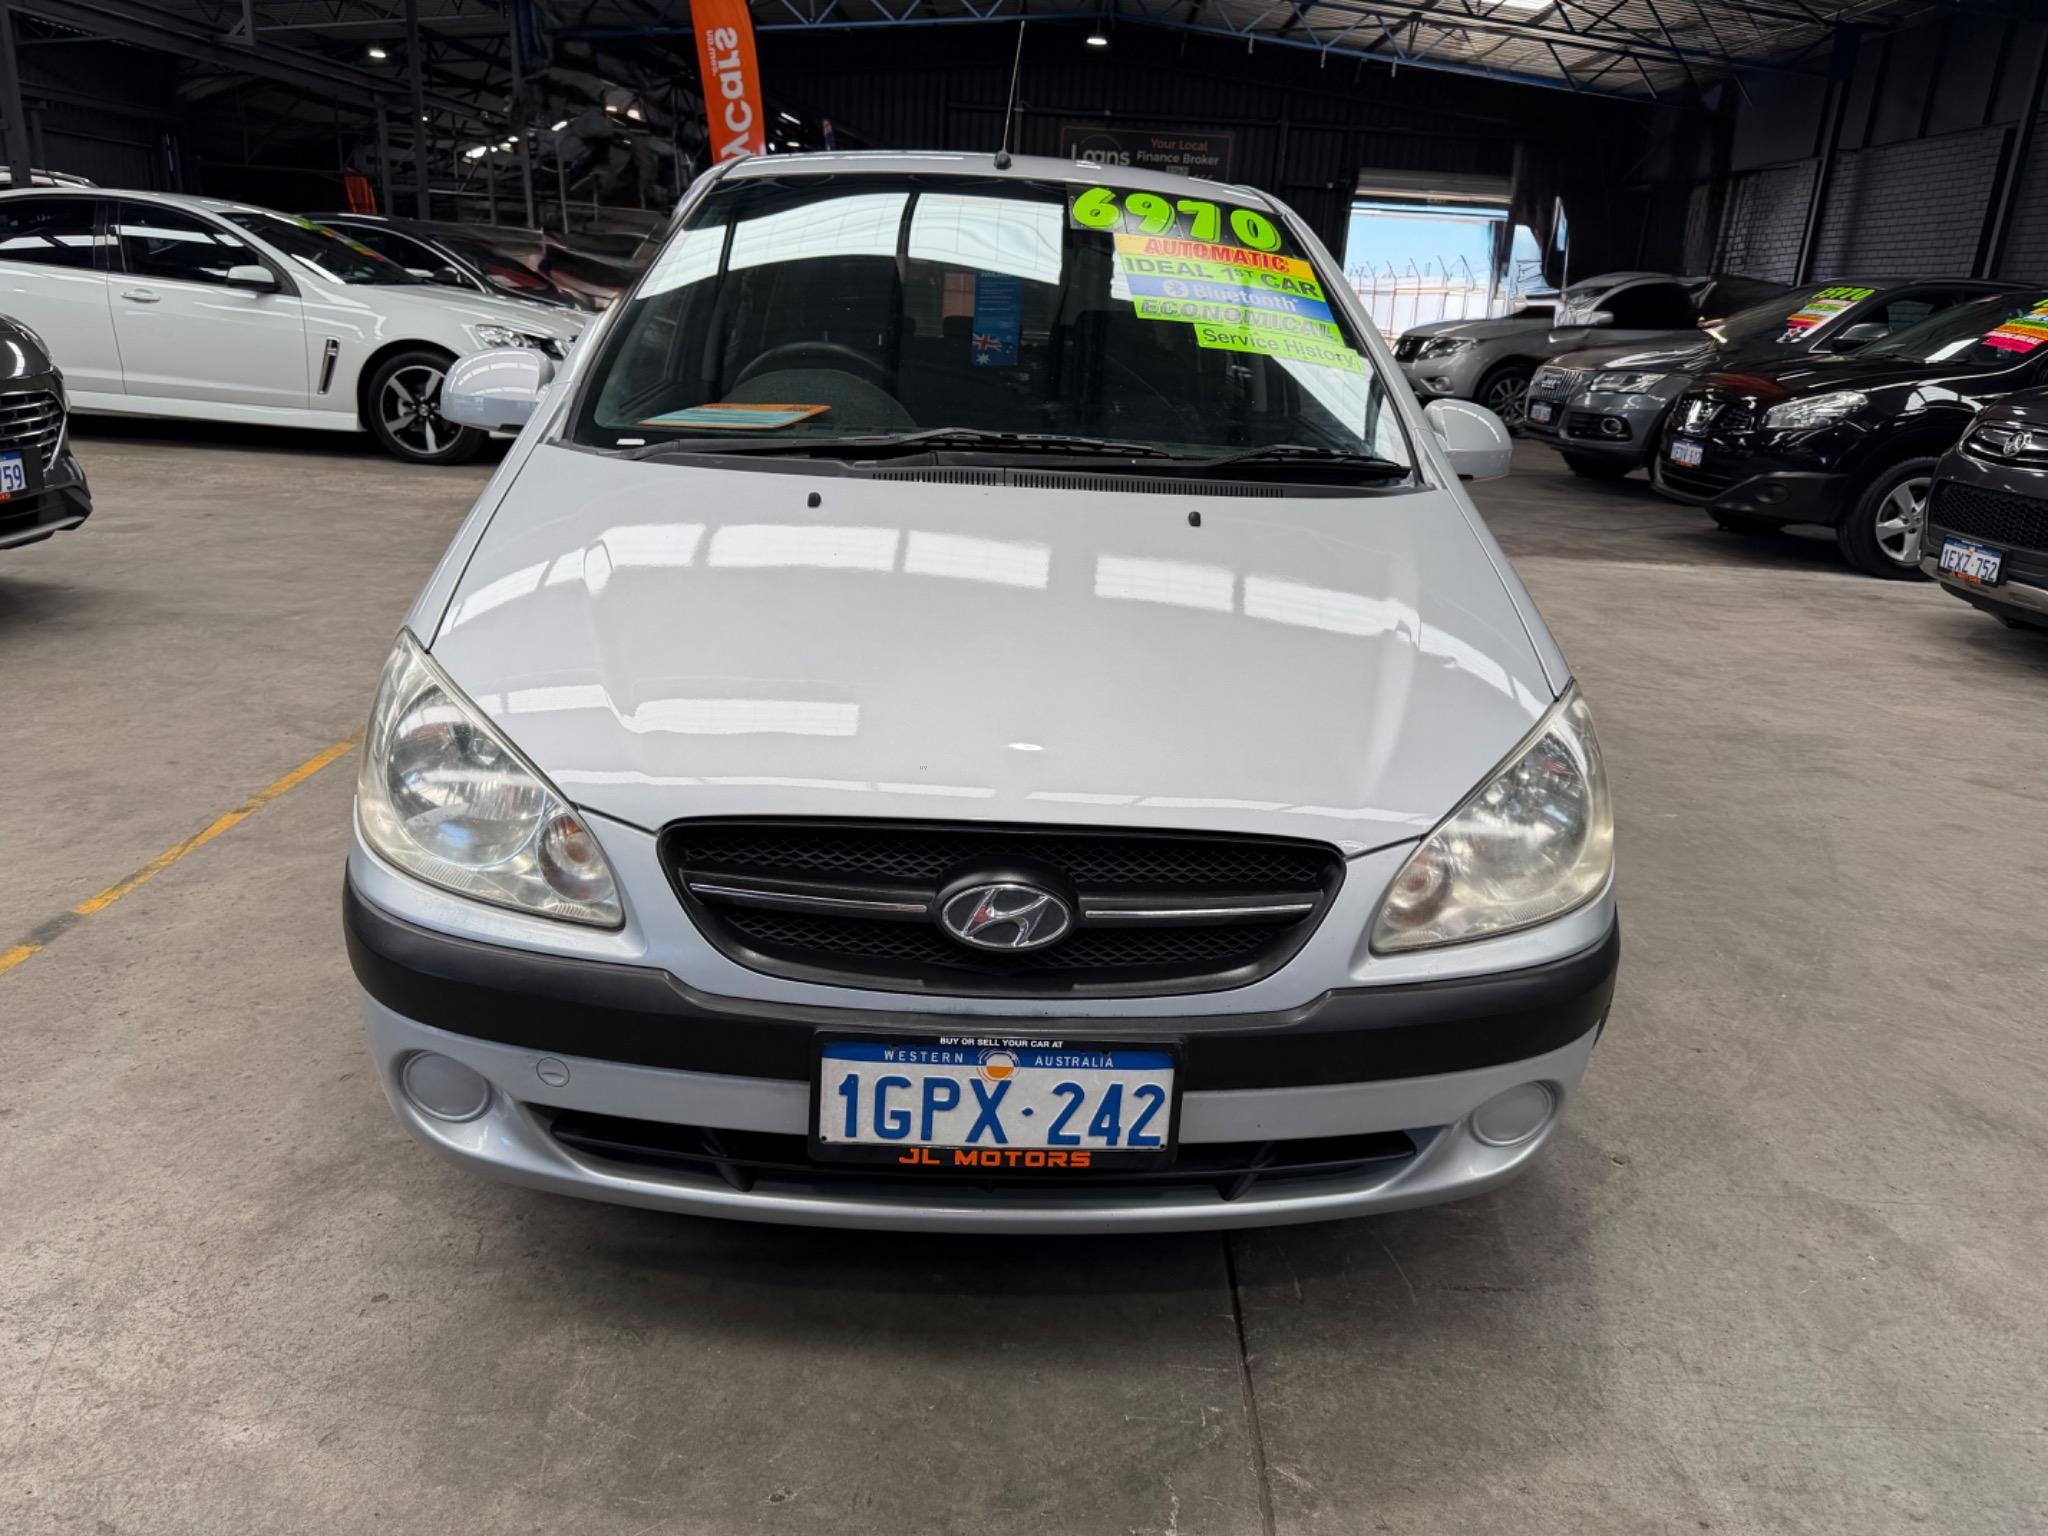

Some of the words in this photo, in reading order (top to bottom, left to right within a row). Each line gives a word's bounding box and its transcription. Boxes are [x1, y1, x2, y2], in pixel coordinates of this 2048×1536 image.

[1071, 143, 1131, 166] Loans
[1136, 150, 1180, 163] Finance
[1182, 153, 1220, 166] Broker
[1151, 138, 1176, 150] Your
[1179, 140, 1209, 152] Local
[1072, 187, 1281, 251] 6970
[1144, 238, 1290, 273] AUTOMATIC
[1125, 257, 1214, 279] IDEAL
[1260, 272, 1320, 298] CAR
[1194, 284, 1297, 312] Bluetooth
[1142, 300, 1335, 339] ECONOMICAL
[1202, 328, 1280, 350] Service
[1283, 339, 1355, 367] History
[0, 464, 23, 490] 59
[940, 1037, 959, 1045] BUY
[961, 1038, 975, 1046] OR
[977, 1038, 1000, 1046] SELL
[1002, 1039, 1028, 1047] YOUR
[1030, 1040, 1050, 1048] CAR
[1051, 1041, 1064, 1049] AT
[884, 1050, 964, 1063] WESTERN
[1034, 1055, 1114, 1068] AUSTRALIA
[899, 1148, 941, 1165] JL
[954, 1149, 1092, 1167] MOTORS
